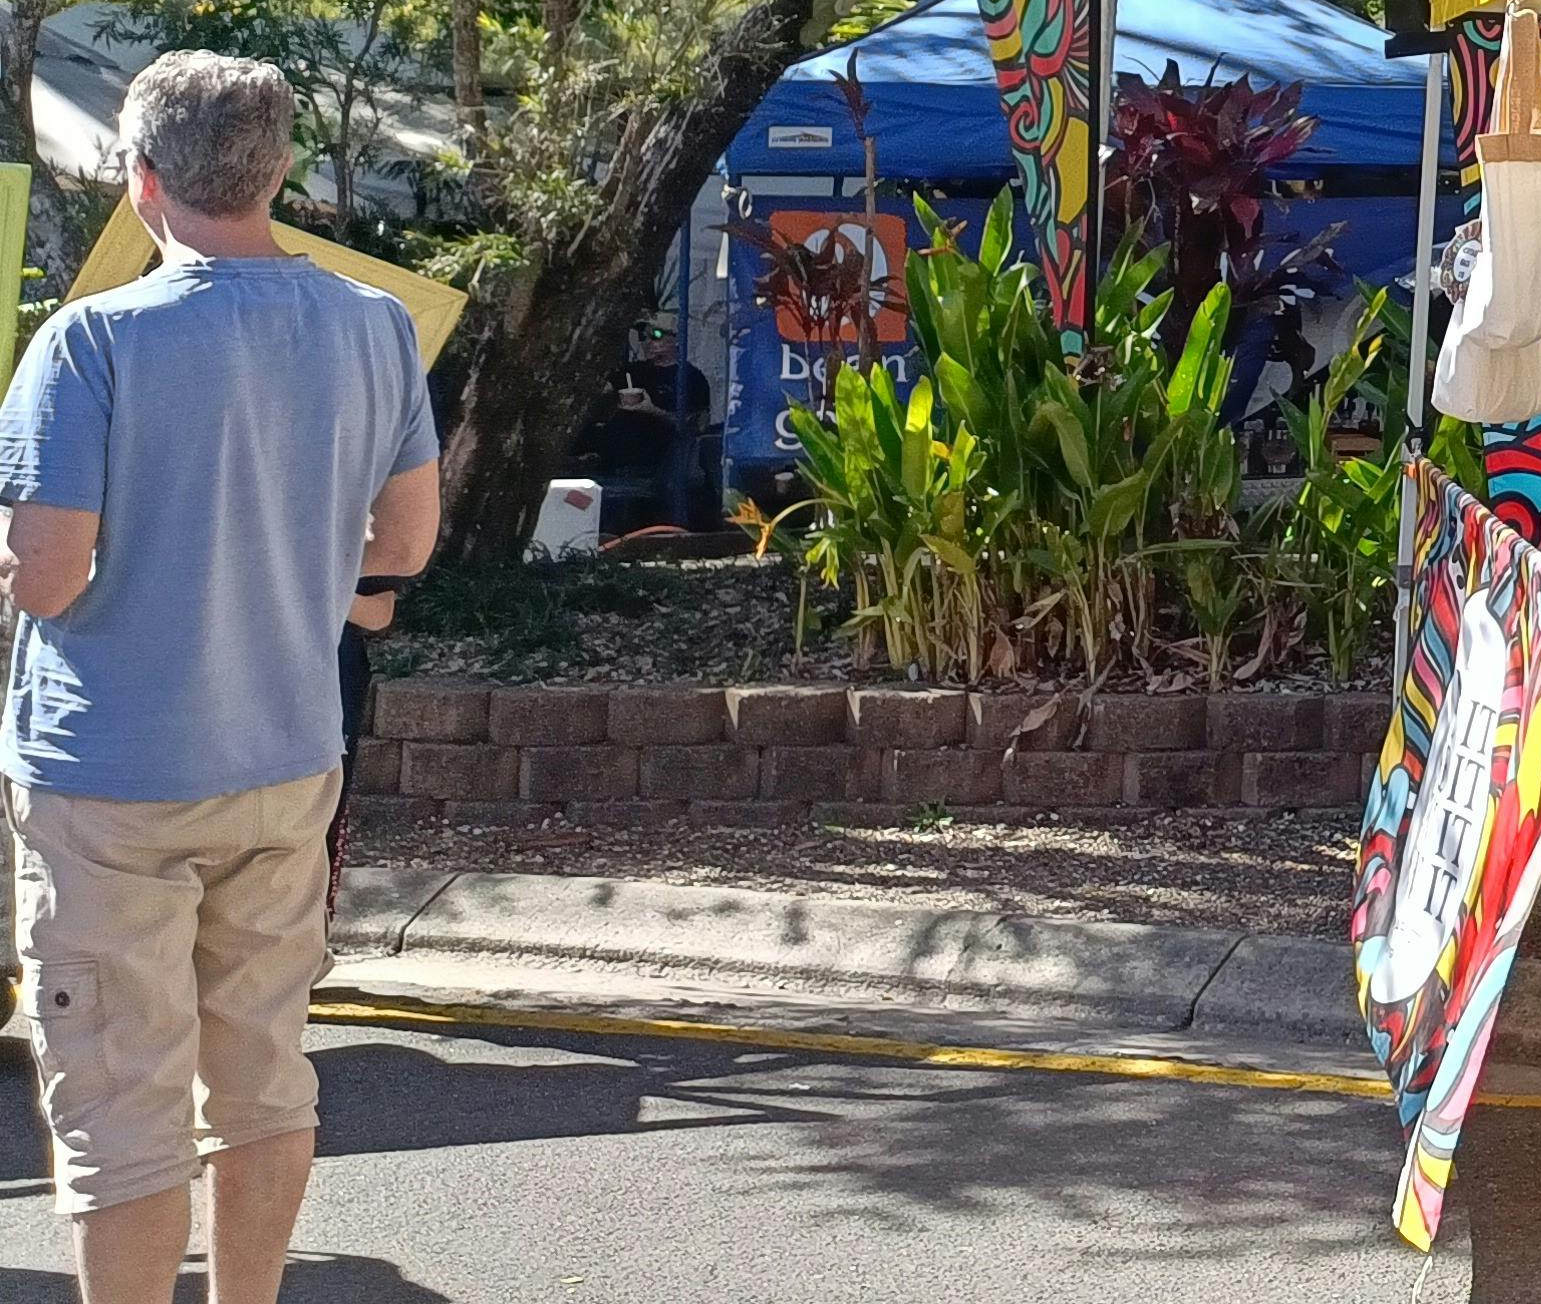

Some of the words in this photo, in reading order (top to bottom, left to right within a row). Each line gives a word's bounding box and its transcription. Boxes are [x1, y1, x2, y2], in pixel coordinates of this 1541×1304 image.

[781, 344, 908, 383] ben
[1460, 699, 1496, 755] IT
[1447, 753, 1485, 811] IT
[1435, 808, 1472, 868] IT
[1423, 864, 1458, 923] IT
